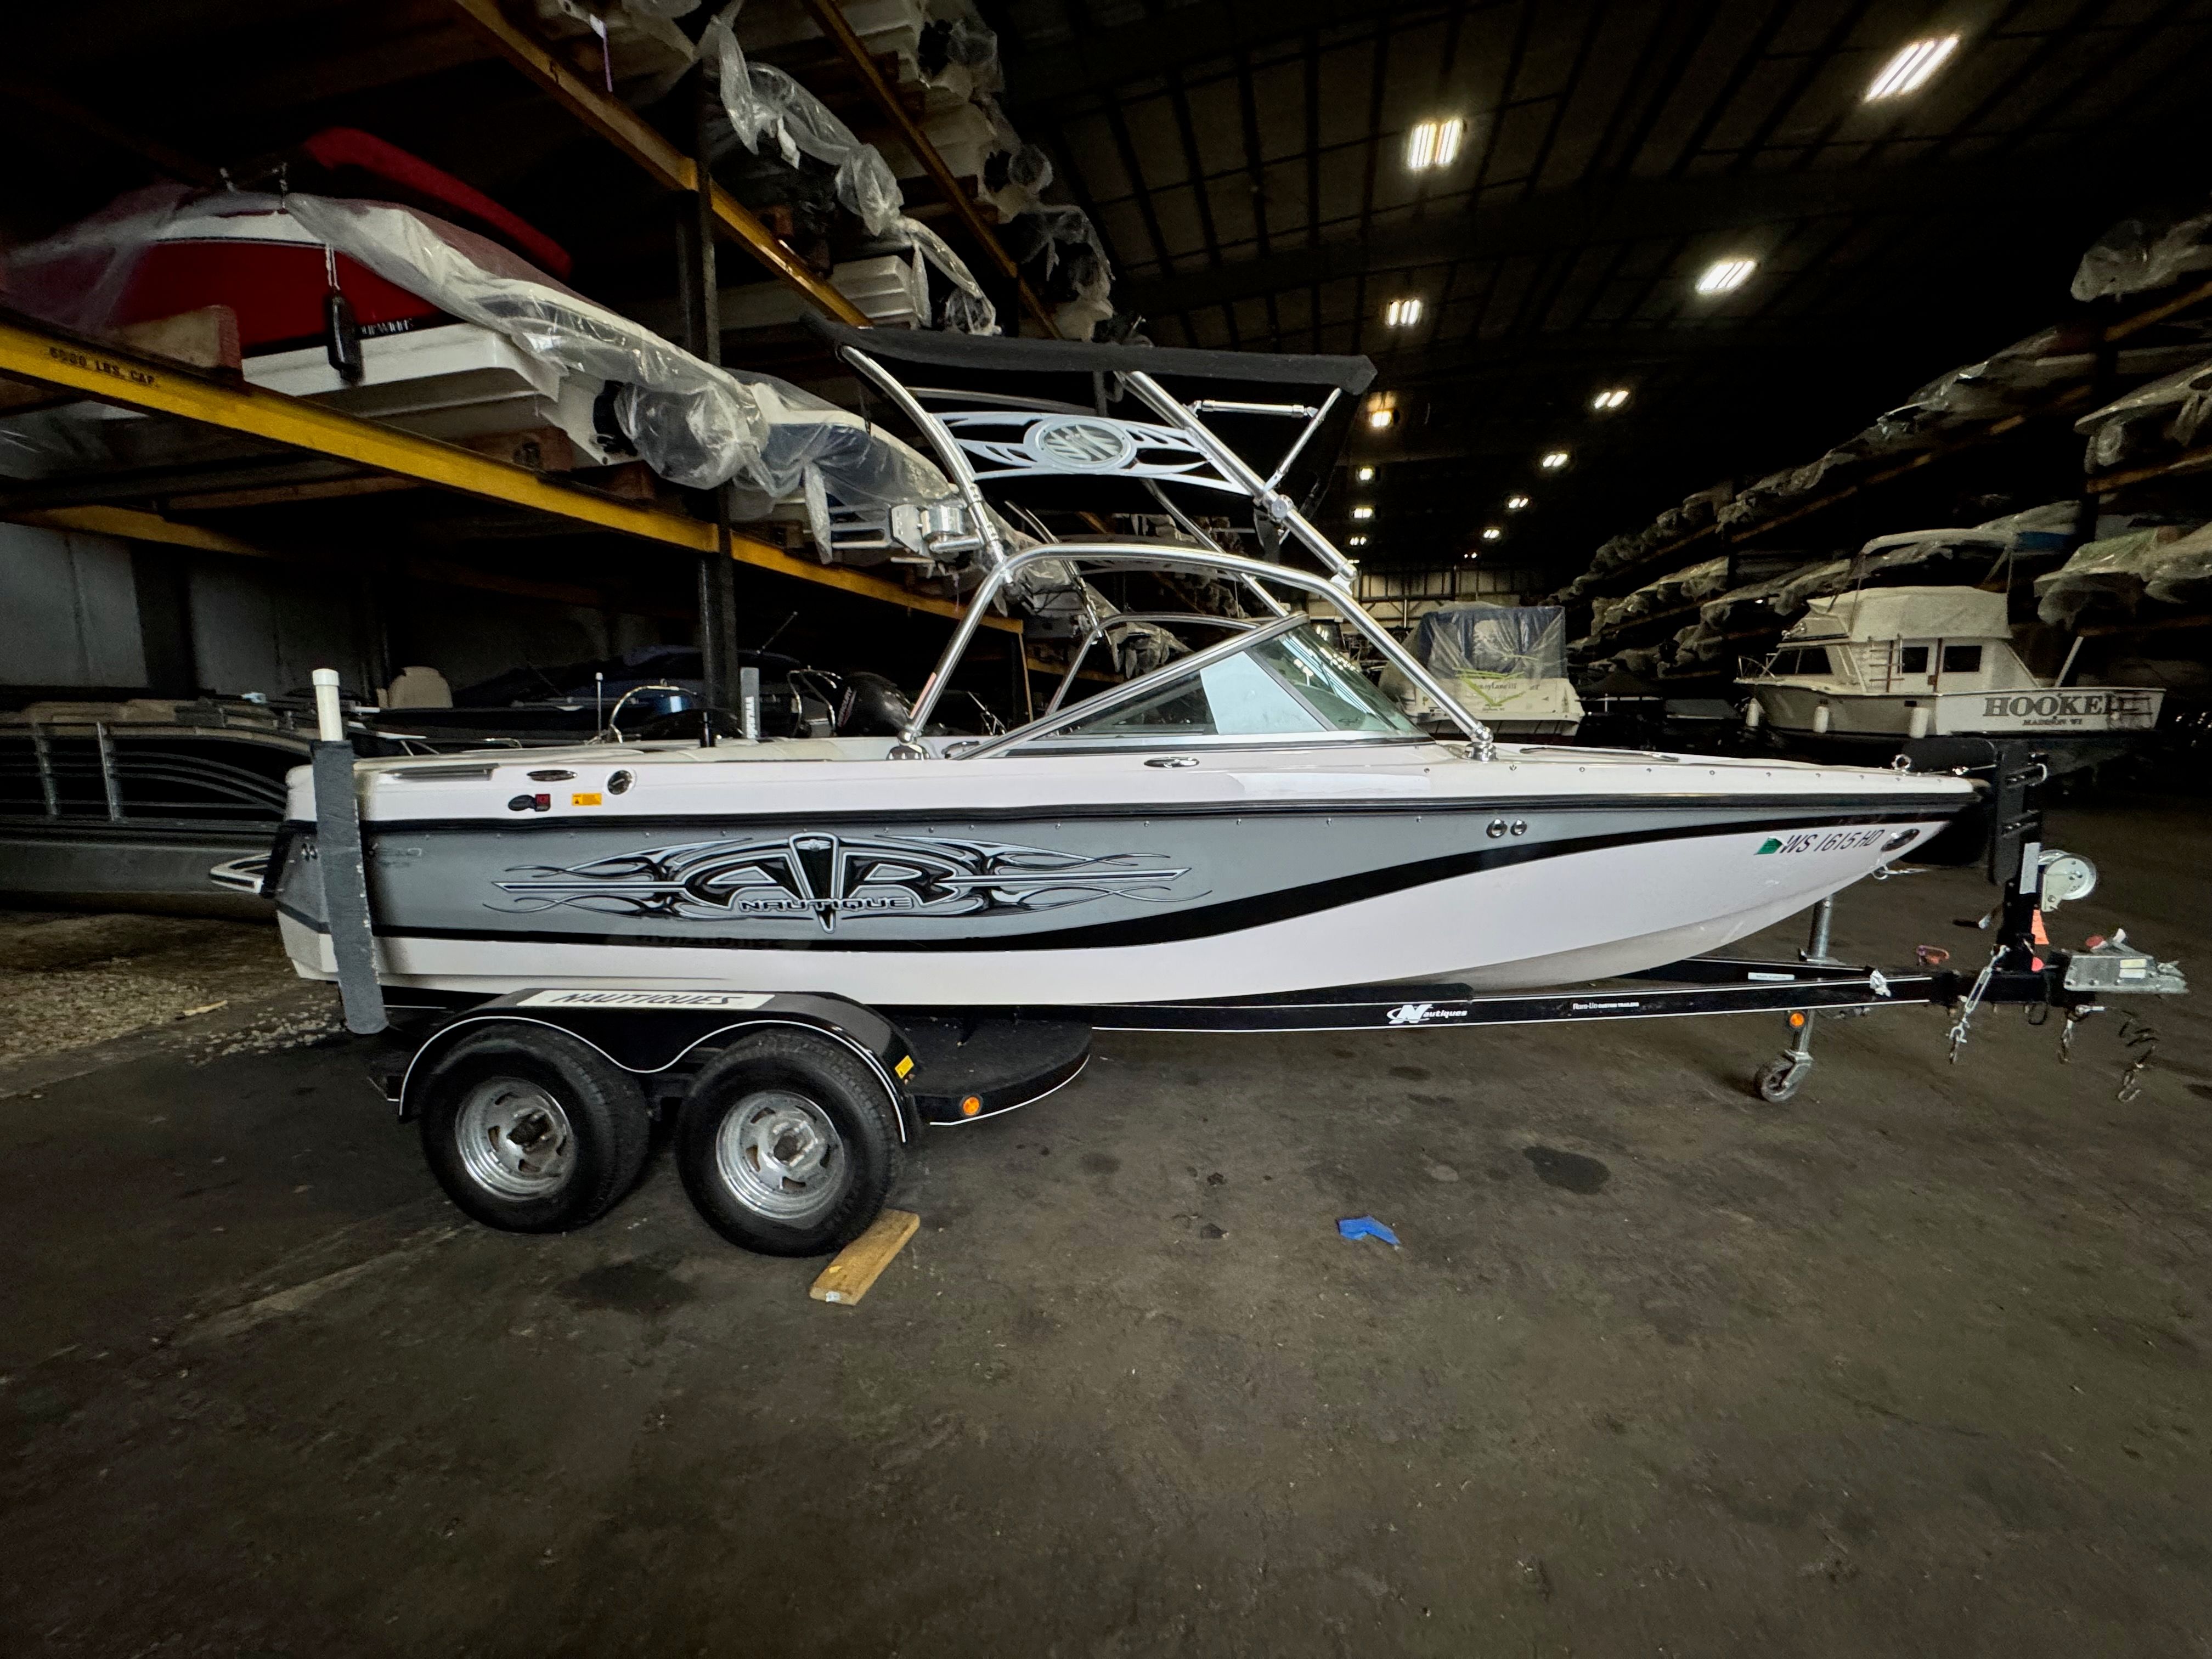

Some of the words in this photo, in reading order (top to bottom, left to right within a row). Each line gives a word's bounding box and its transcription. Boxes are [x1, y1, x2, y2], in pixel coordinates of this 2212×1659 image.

[1780, 833, 1818, 854] WS
[740, 896, 912, 911] NAUTIQUE
[549, 993, 744, 1006] NAUTIQUES
[1387, 1003, 1468, 1024] Nautiques
